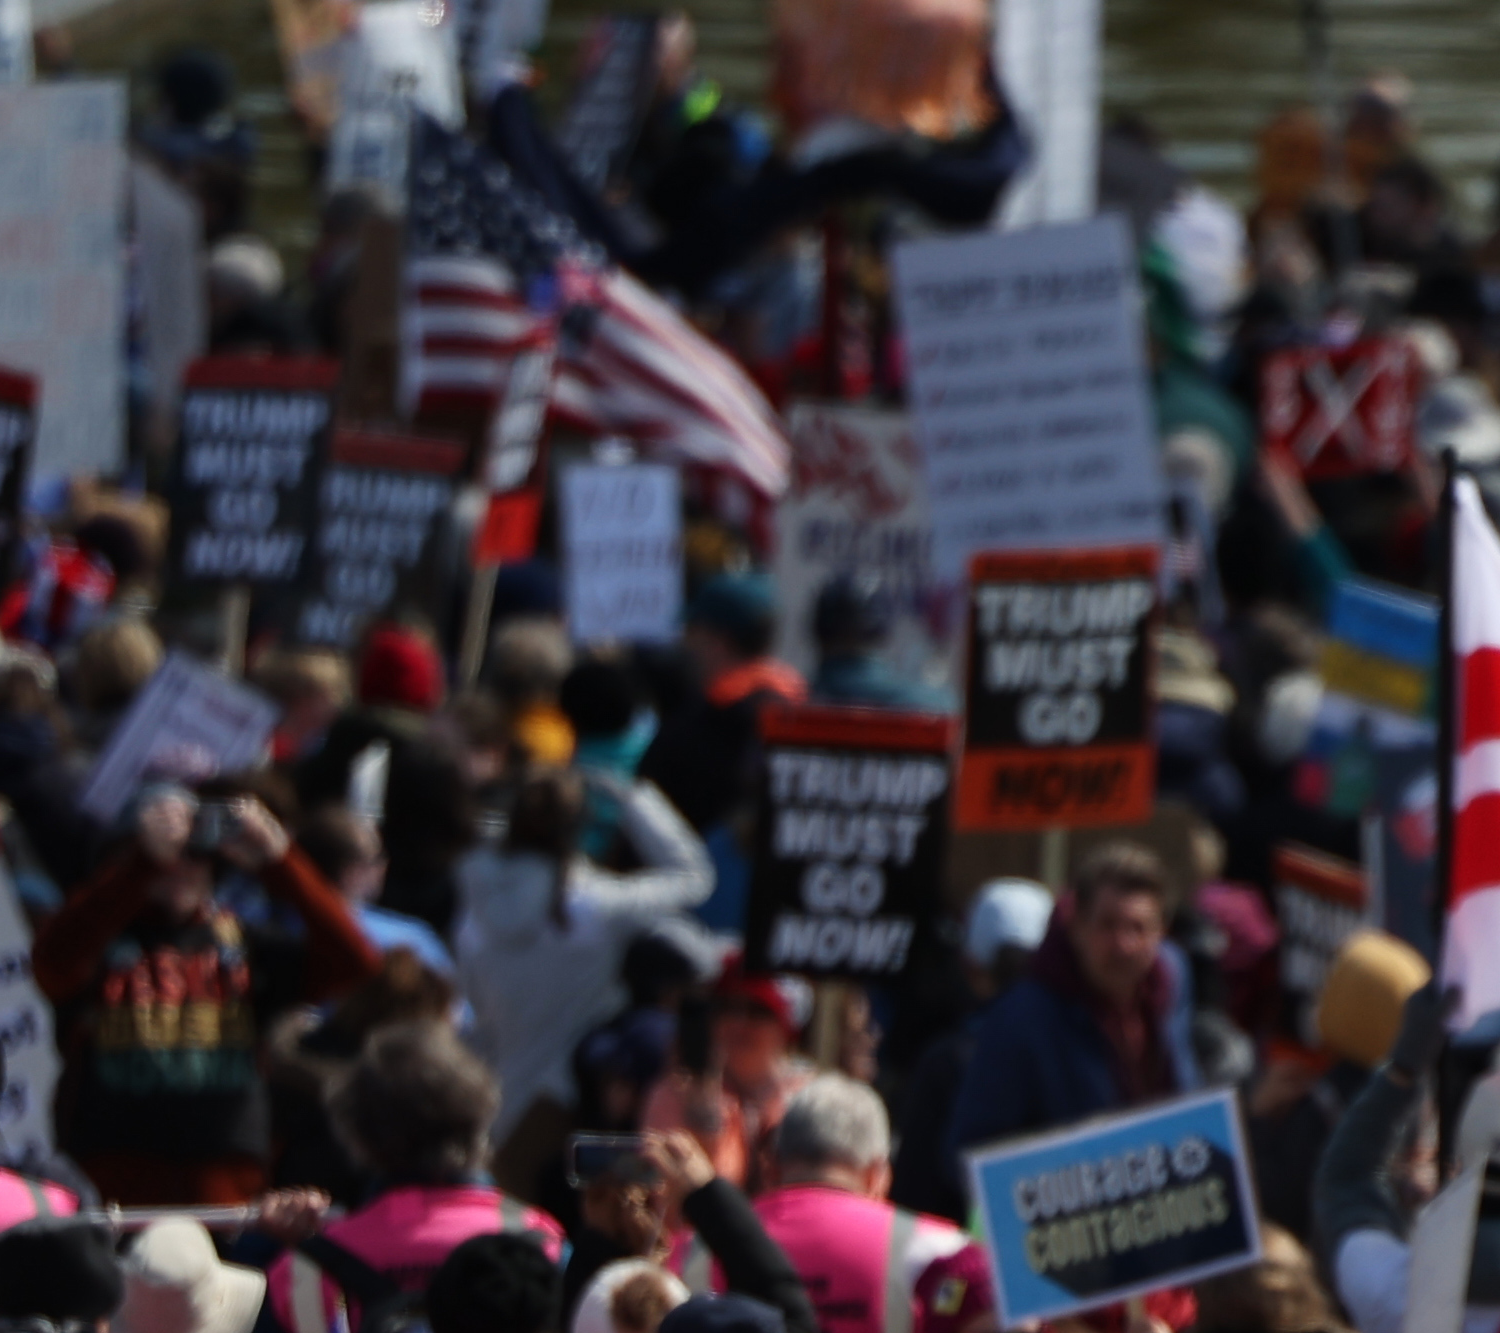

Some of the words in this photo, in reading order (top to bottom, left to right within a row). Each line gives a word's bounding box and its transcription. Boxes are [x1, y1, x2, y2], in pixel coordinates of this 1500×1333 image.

[975, 582, 1154, 636] TRUMP
[987, 636, 1138, 690] MUST
[1018, 692, 1103, 746] GO
[771, 751, 946, 808] TRUMP
[775, 808, 929, 867] MUST
[804, 862, 885, 917] GO
